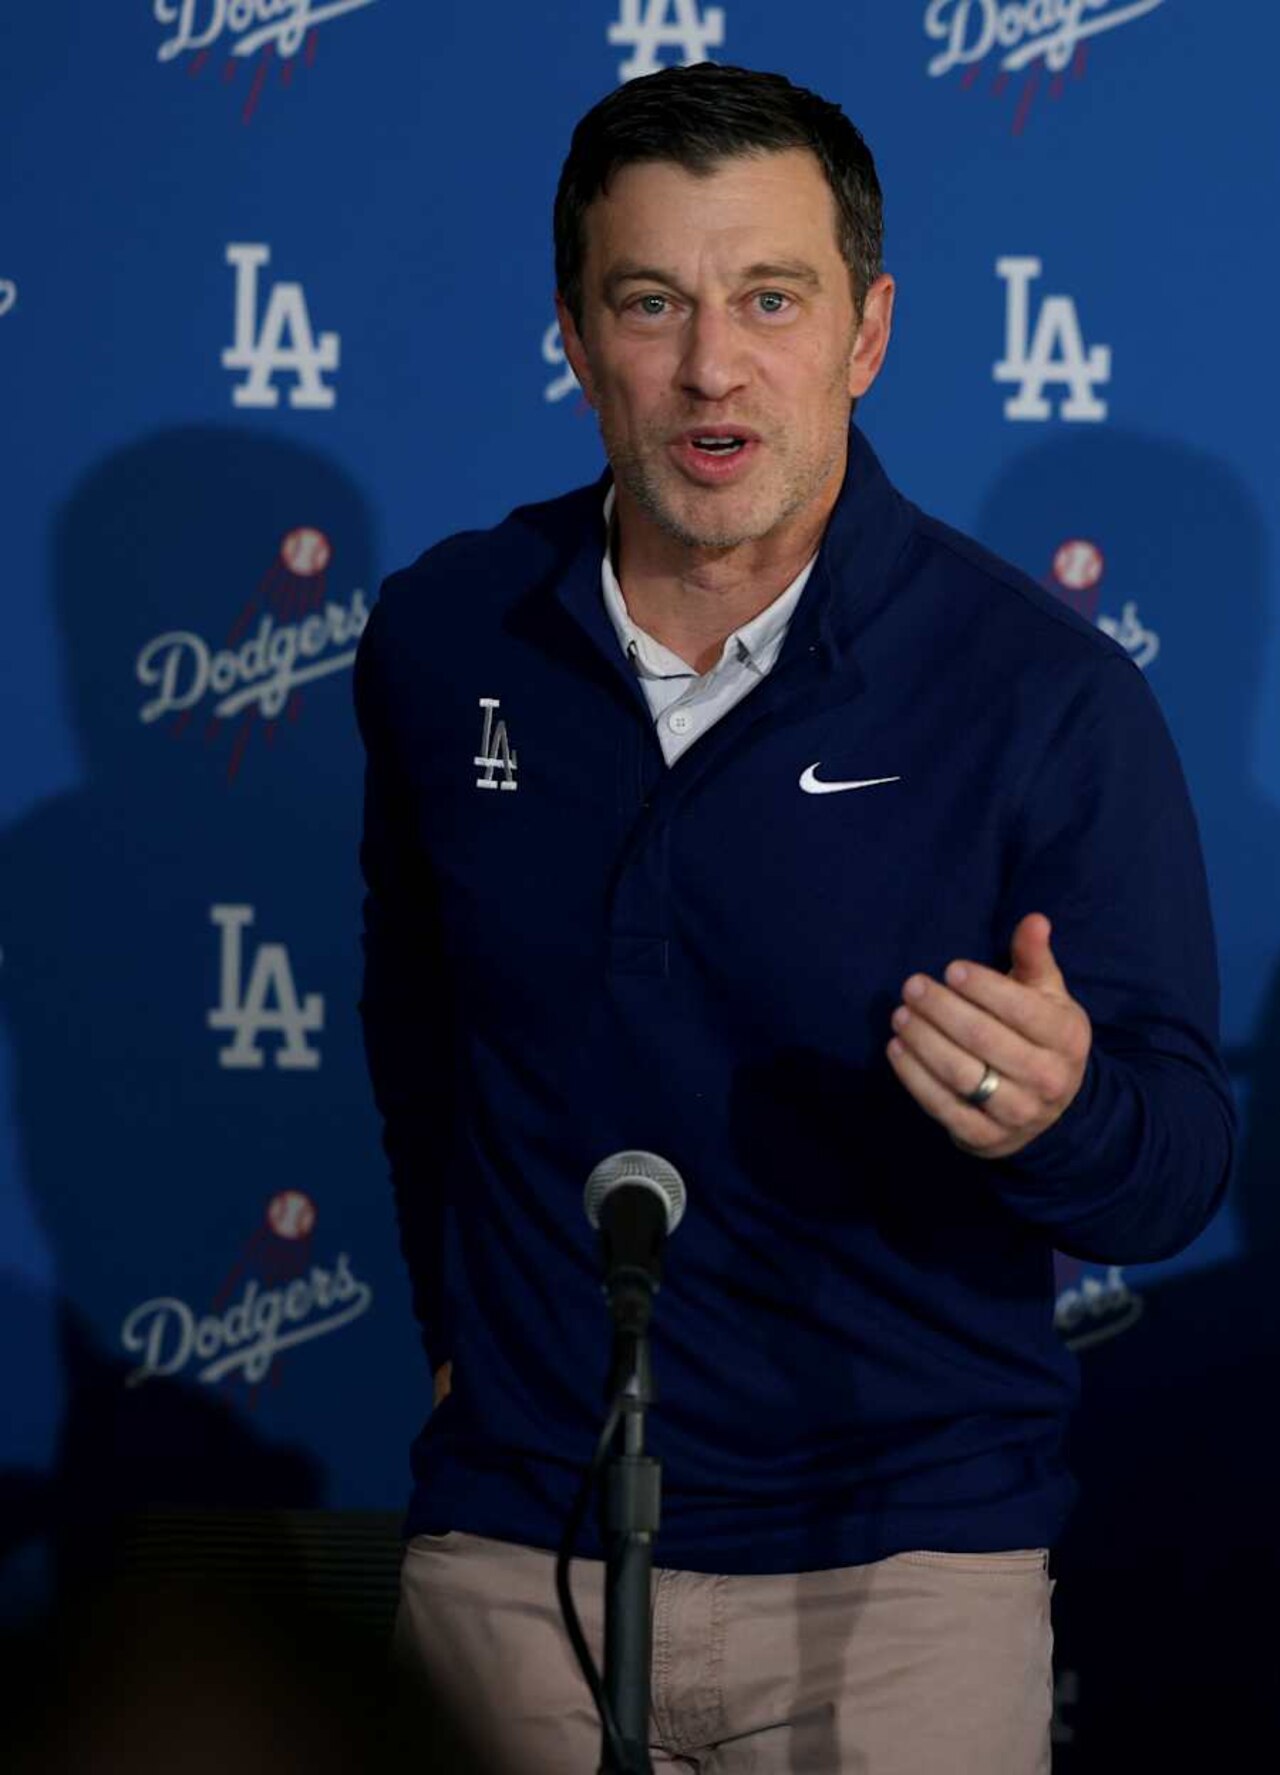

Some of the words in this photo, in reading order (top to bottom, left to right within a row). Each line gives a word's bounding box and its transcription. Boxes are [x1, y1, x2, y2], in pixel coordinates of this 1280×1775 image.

[221, 243, 340, 409] LA
[992, 256, 1112, 422] LA
[473, 697, 519, 792] LA
[208, 904, 326, 1070] LA
[121, 1252, 371, 1388] Dodgers
